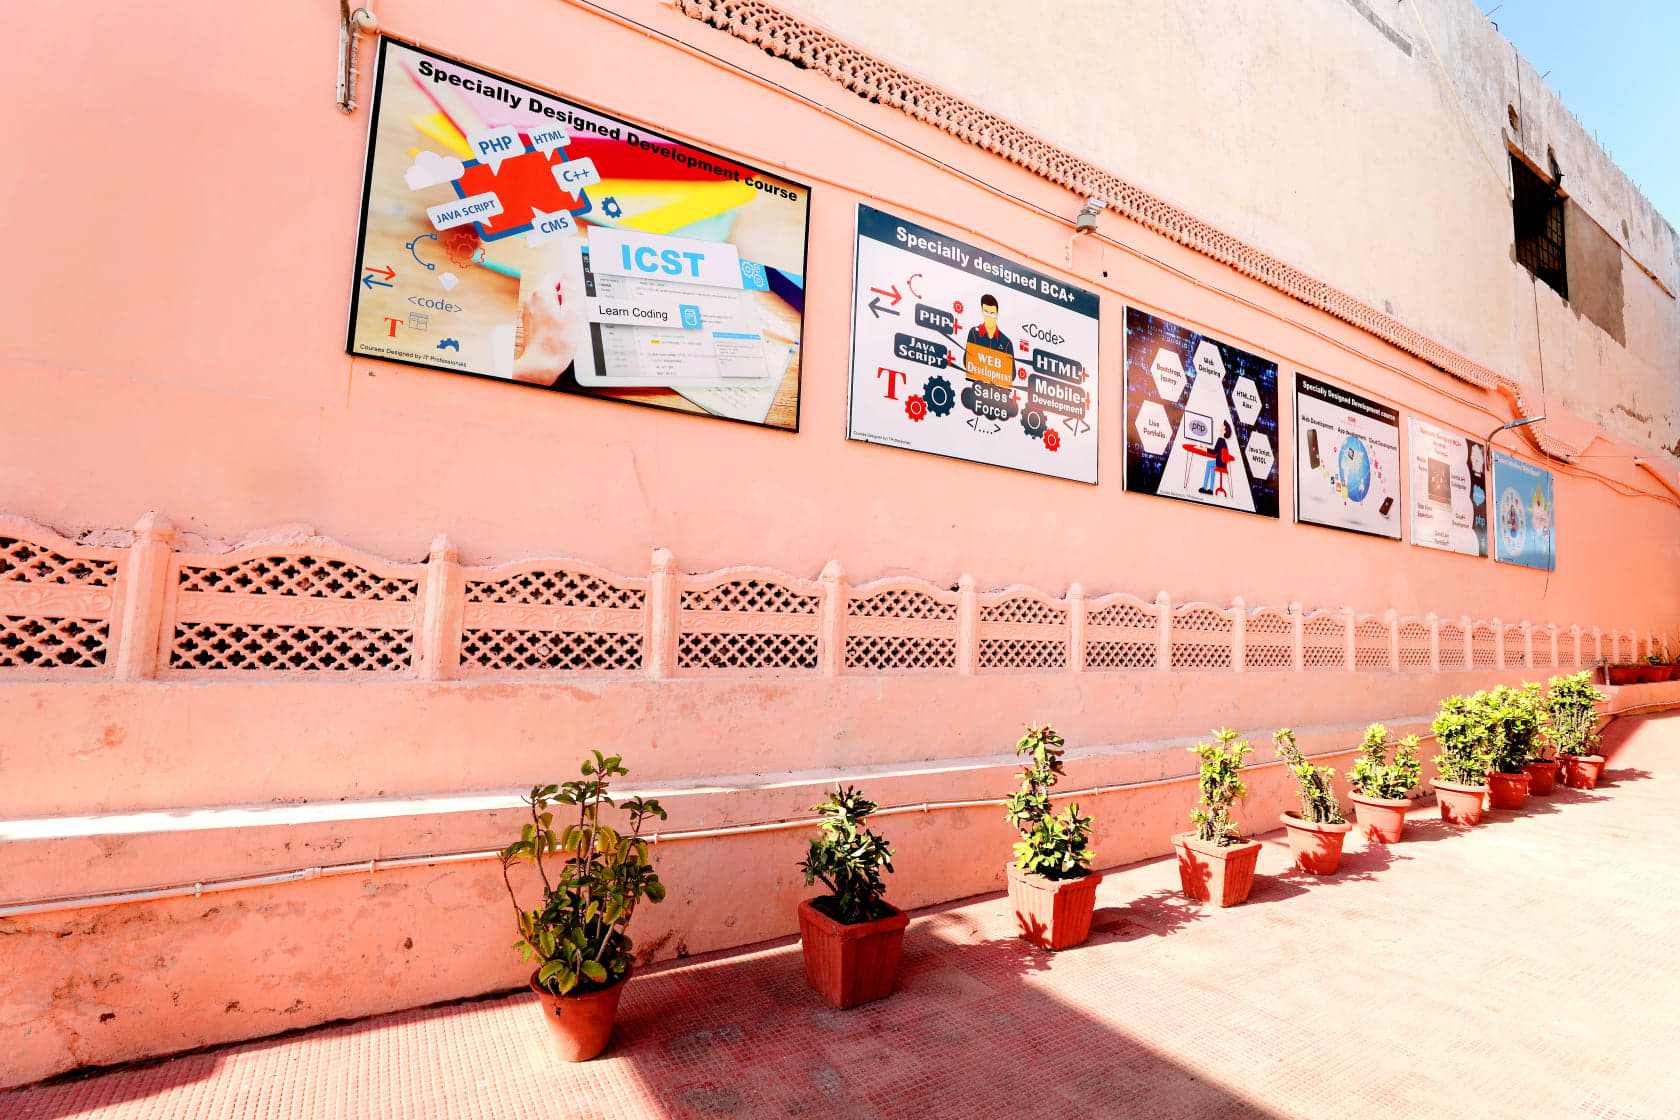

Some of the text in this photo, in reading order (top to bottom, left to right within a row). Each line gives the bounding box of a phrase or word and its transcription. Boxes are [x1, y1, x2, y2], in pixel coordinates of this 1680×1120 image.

[418, 60, 798, 202] Specially Designed Development course
[533, 130, 565, 145] HTML
[478, 135, 513, 155] PHP
[563, 168, 590, 183] C++
[436, 199, 496, 224] JAVA SCRIPT
[540, 217, 569, 234] CMS
[621, 244, 705, 277] ICST
[895, 226, 1075, 304] Specially designed BCA+
[599, 305, 668, 321] Learn Coding
[919, 309, 951, 328] PHP
[384, 317, 404, 338] T
[976, 352, 1003, 369] WEB
[1036, 357, 1080, 380] HTML
[877, 366, 907, 401] T
[1034, 378, 1081, 405] Mobile
[974, 384, 1008, 404] Sales
[1302, 380, 1327, 398] Specially
[1327, 389, 1351, 405] Designed
[1351, 398, 1381, 416] Development
[974, 400, 1008, 420] Force
[1032, 394, 1083, 416] Development
[1191, 421, 1206, 433] php
